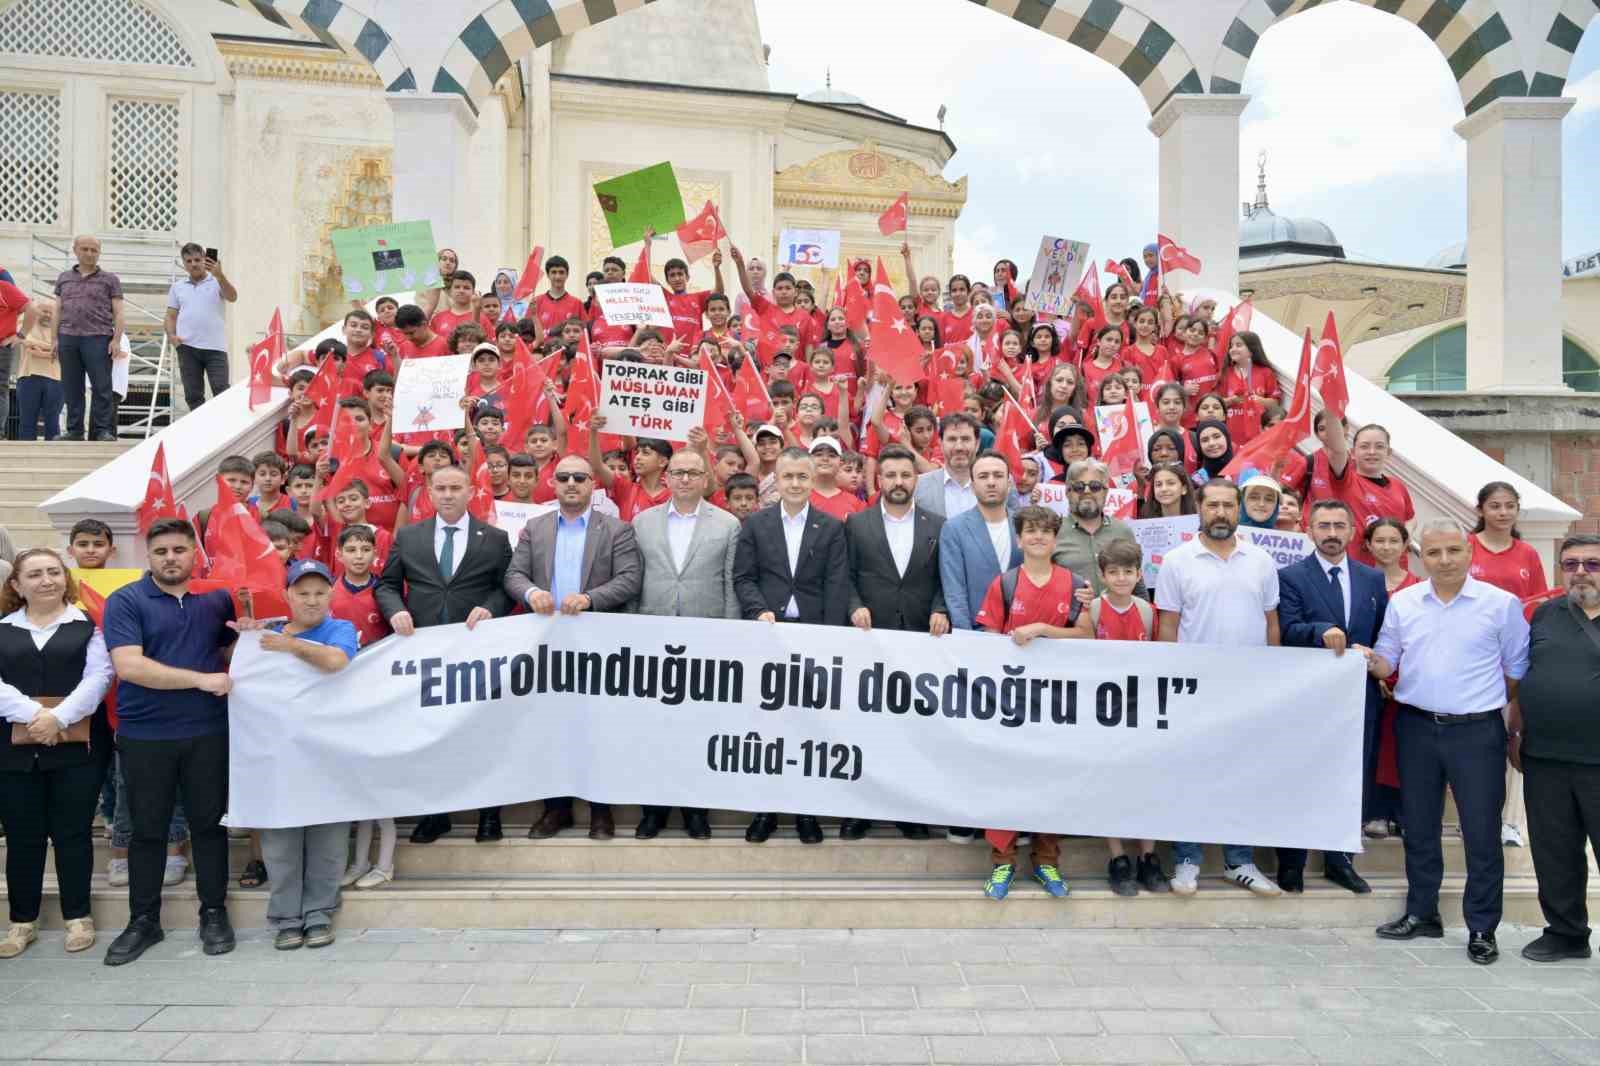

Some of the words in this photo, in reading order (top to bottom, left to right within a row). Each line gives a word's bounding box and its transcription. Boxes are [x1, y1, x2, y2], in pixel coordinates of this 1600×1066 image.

[605, 364, 668, 381] TOPRAK
[674, 368, 704, 385] GİBİ
[610, 378, 700, 399] MÜSLÜMAN
[608, 395, 651, 411] ATEŞ
[662, 398, 695, 414] GİBİ
[629, 415, 673, 431] TÜRK
[1044, 488, 1063, 503] BU
[1251, 531, 1303, 551] VATAN
[760, 654, 843, 711] gibi
[859, 663, 1078, 727] dosdoğru
[1095, 675, 1139, 729] ol
[706, 732, 863, 781] (Hûd-112)
